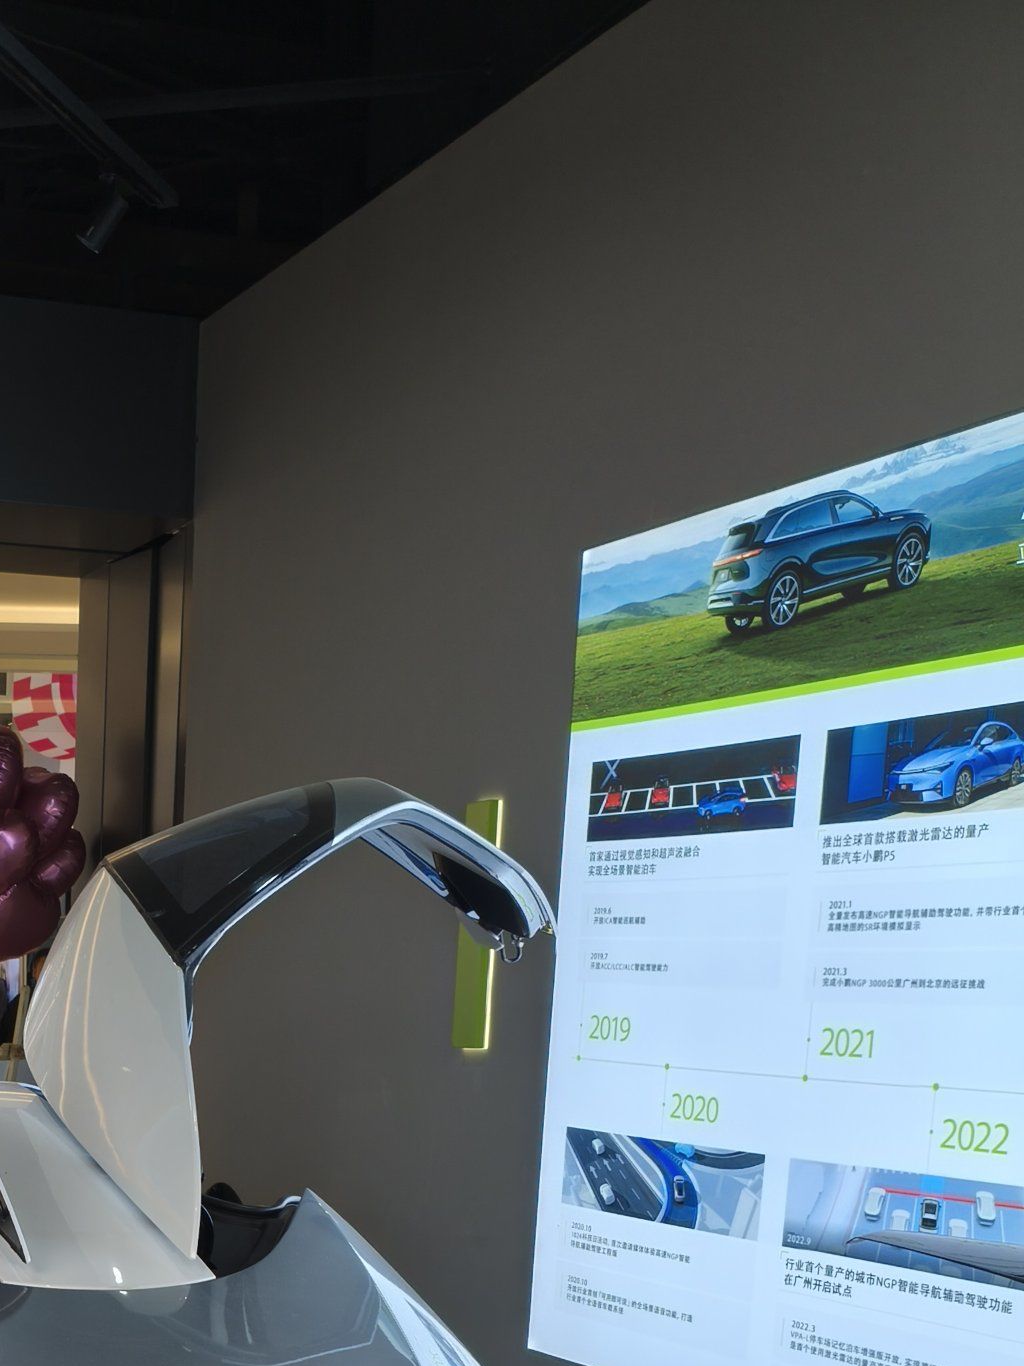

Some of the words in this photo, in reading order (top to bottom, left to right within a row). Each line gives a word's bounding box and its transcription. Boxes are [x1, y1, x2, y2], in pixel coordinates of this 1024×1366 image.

[822, 823, 990, 849] 推出全球首款搭载激光雷达的量产
[588, 864, 656, 876] 实现全场景智能泊车
[821, 850, 896, 865] 智能汽车小鹏P5
[829, 900, 852, 909] 2021.1
[823, 968, 848, 976] 2021.3
[588, 1015, 631, 1043] 2019
[819, 1027, 875, 1059] 2021
[669, 1093, 719, 1125] 2020
[939, 1118, 1010, 1156] 2022
[786, 1233, 812, 1246] 2022.9
[784, 1273, 853, 1299] 在广州开启试点
[785, 1258, 1013, 1314] 行业首个量产的城市NGP智能导航辅助驾驶功能
[791, 1320, 816, 1333] 2022.3
